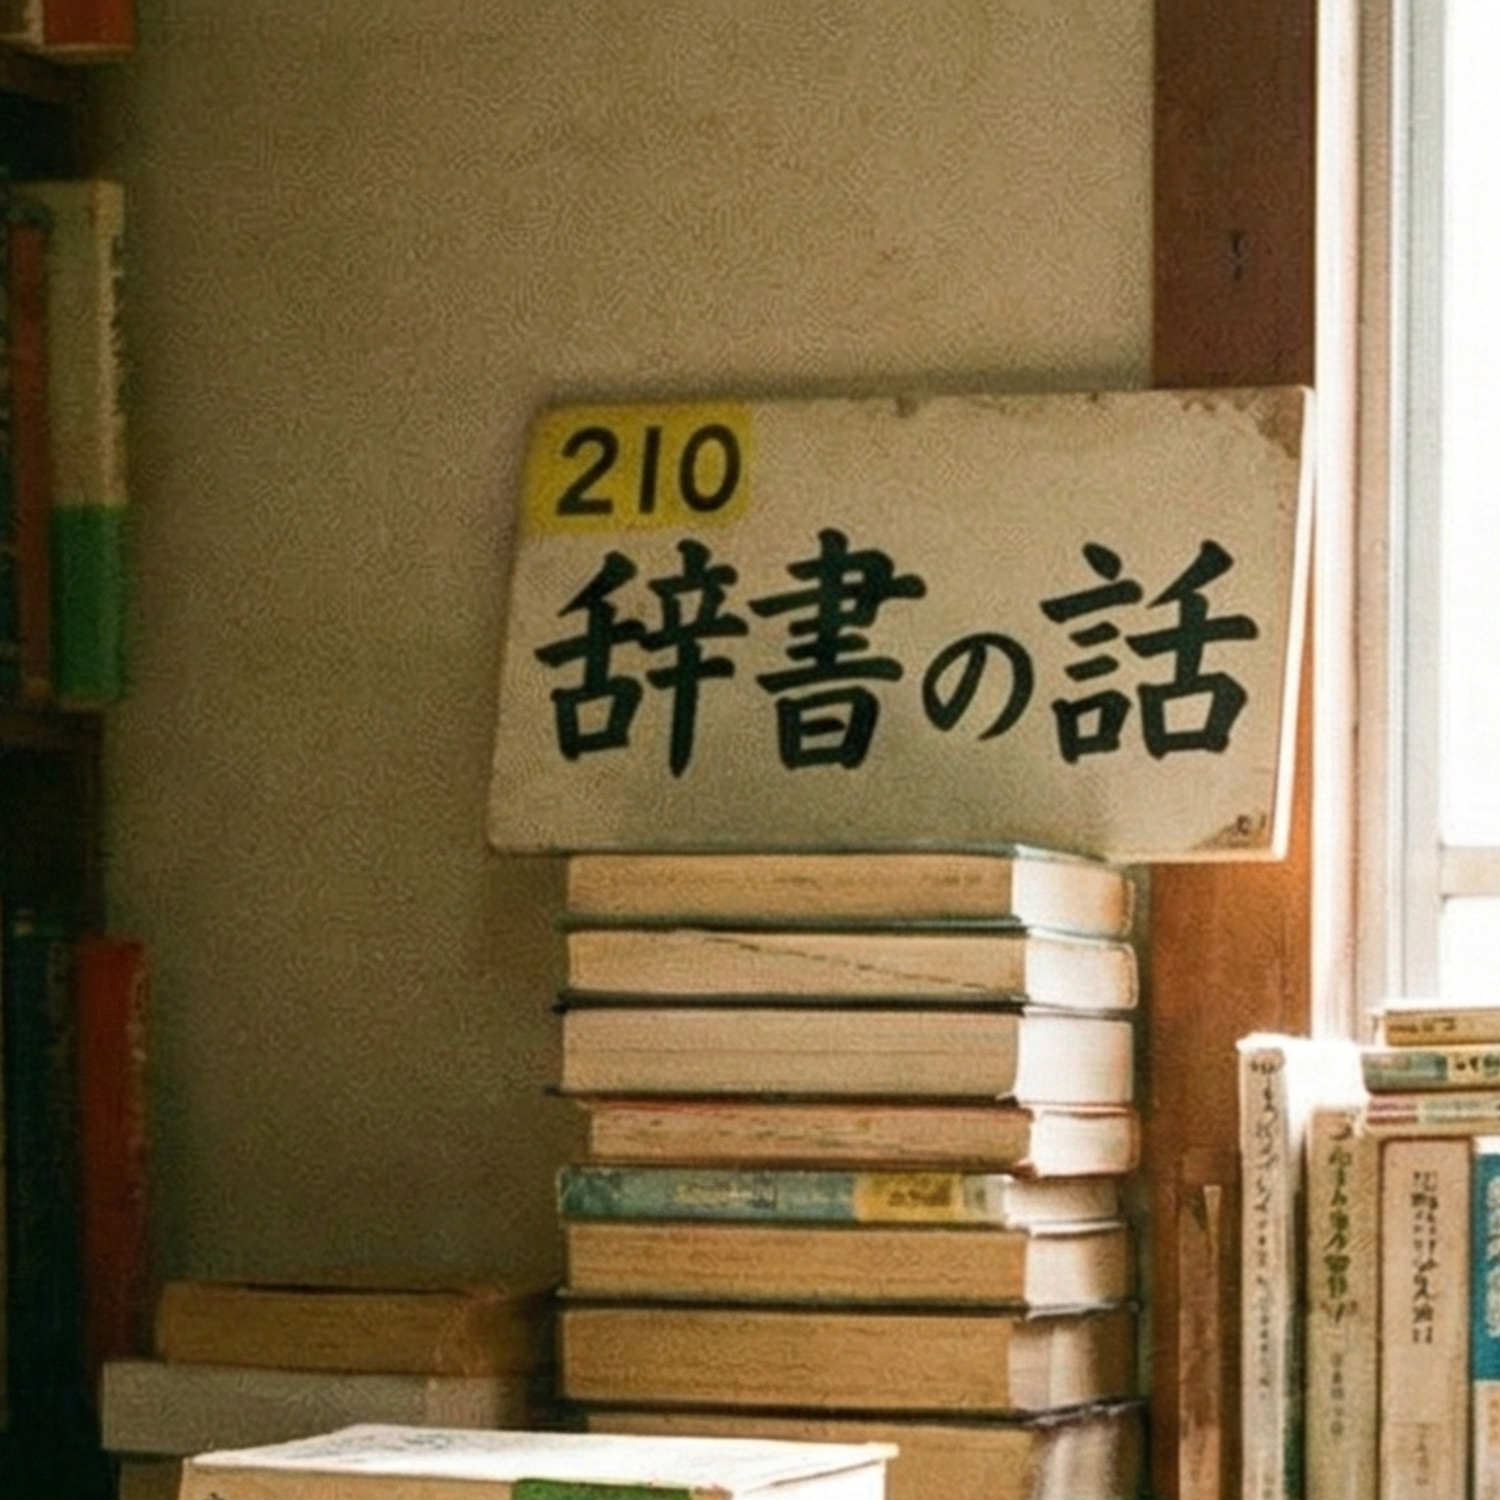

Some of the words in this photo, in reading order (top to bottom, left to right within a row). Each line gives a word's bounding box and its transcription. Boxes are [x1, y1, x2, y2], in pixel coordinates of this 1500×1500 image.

[555, 424, 742, 517] 210
[534, 528, 1259, 778] 辞書の話
